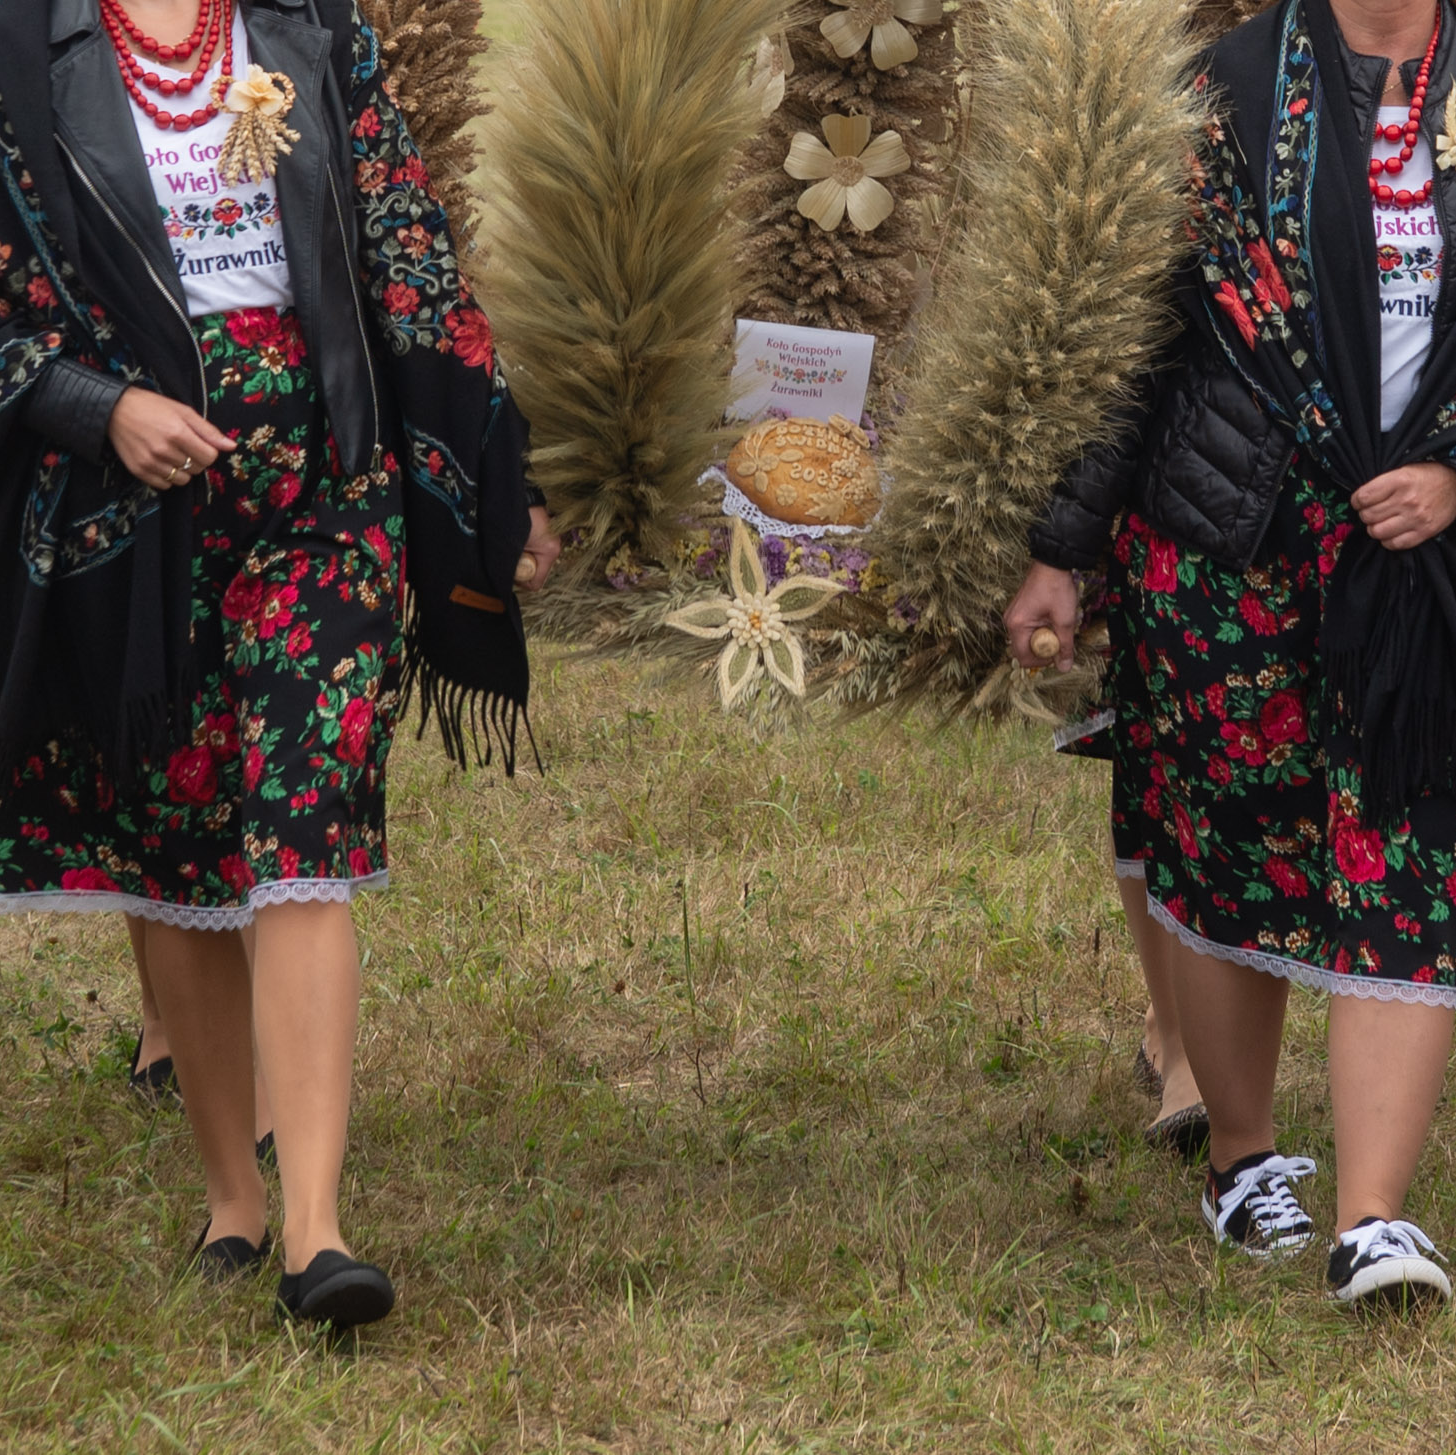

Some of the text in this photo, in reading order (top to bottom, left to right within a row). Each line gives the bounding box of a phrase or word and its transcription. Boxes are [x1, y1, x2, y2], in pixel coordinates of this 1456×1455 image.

[766, 337, 842, 358] Koło Gospodyń
[779, 352, 827, 368] Wiejskich
[770, 380, 823, 398] Żurawniki
[789, 462, 842, 489] 2025
